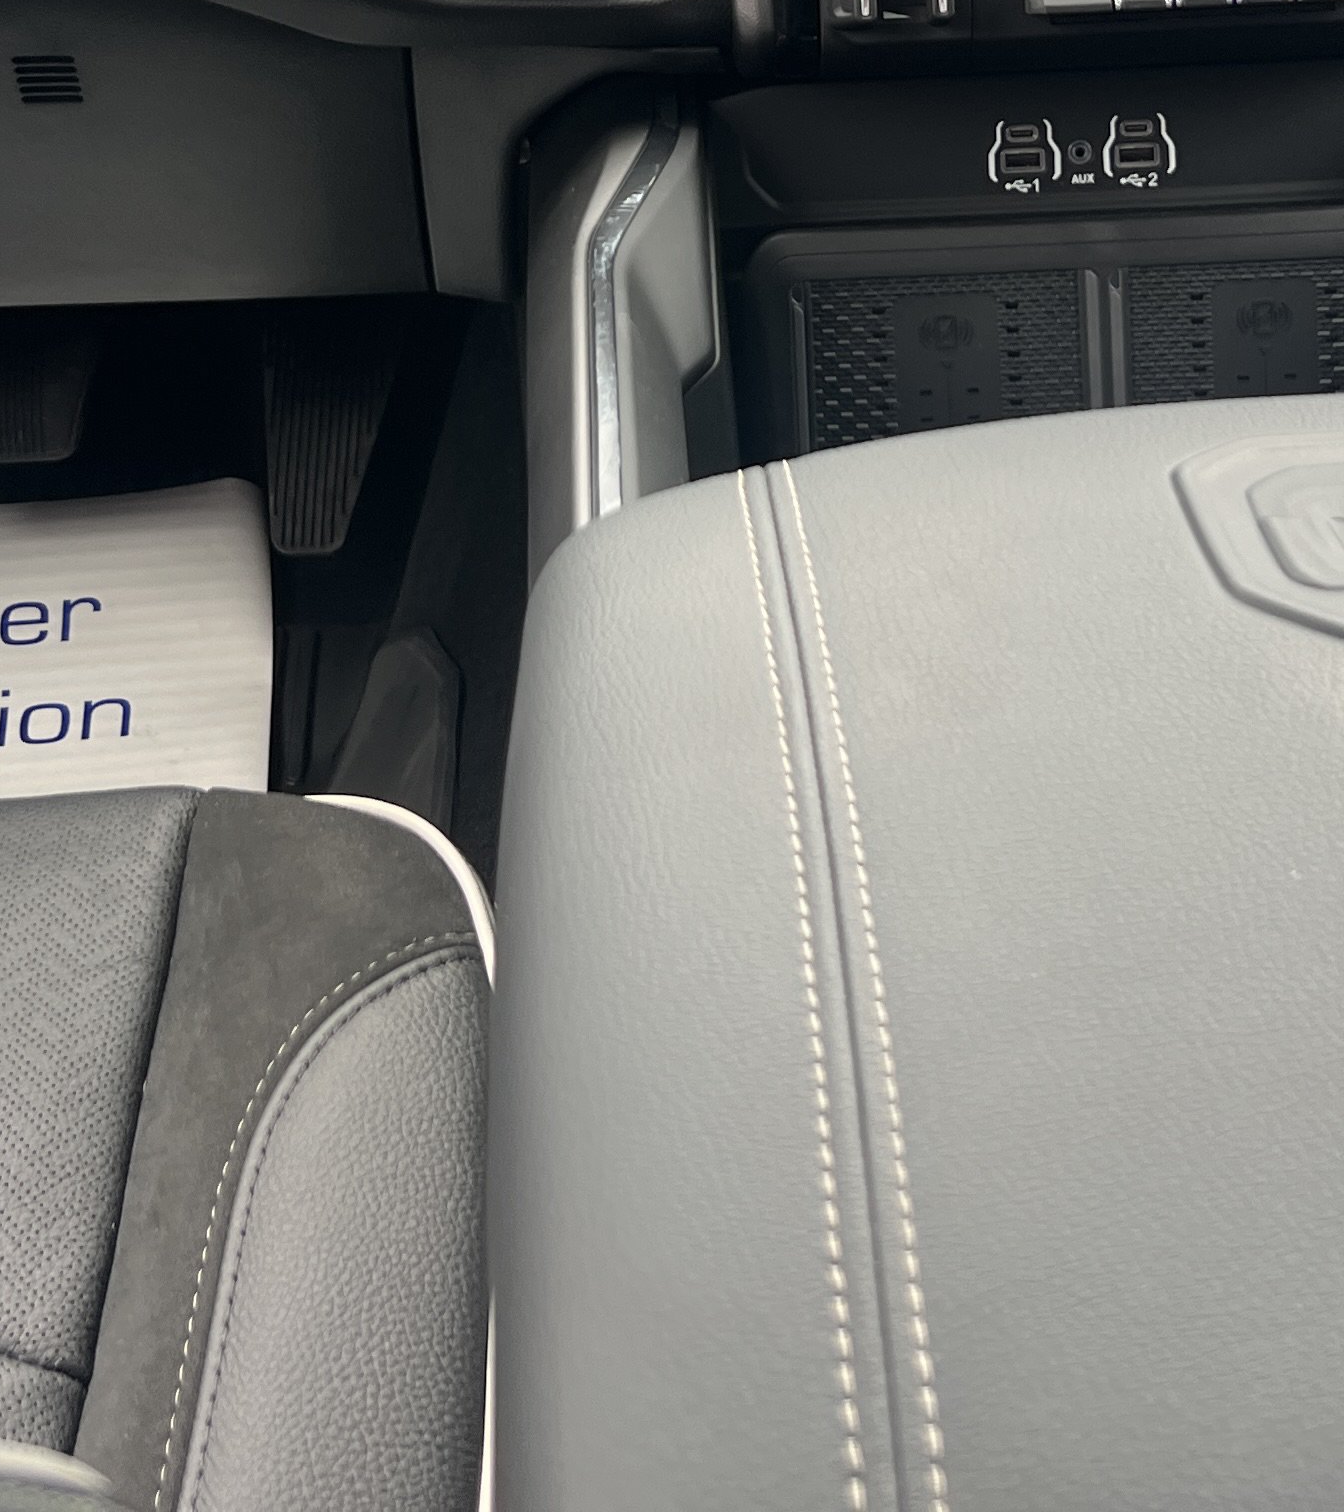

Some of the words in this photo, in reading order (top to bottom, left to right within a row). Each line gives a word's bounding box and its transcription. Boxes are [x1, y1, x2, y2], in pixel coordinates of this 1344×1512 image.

[1032, 178, 1040, 193] 1
[1071, 173, 1095, 184] AUX
[1148, 172, 1158, 187] 2
